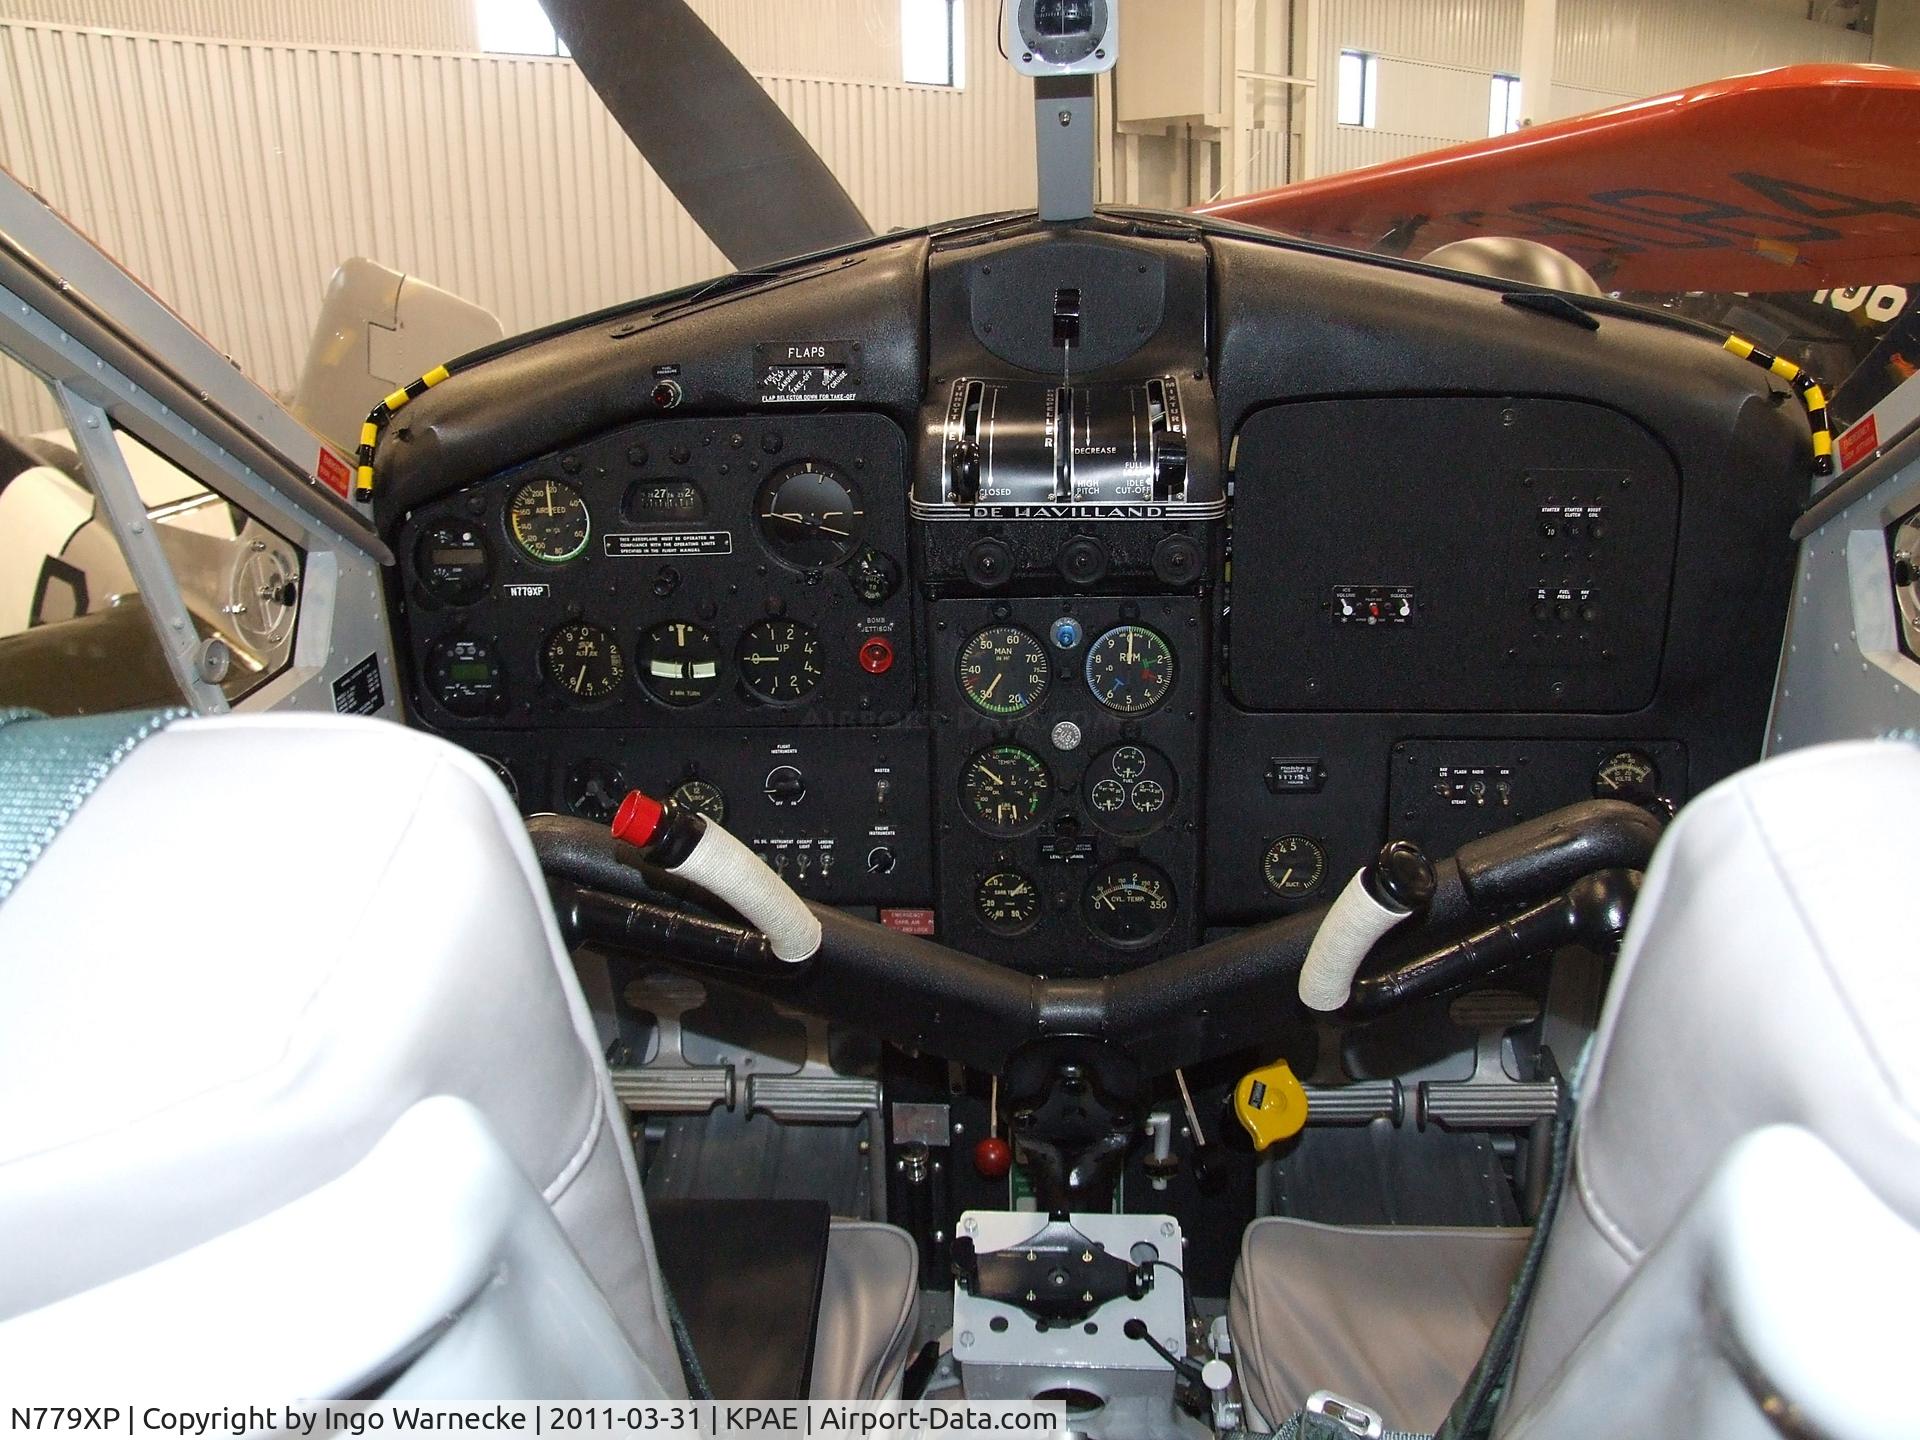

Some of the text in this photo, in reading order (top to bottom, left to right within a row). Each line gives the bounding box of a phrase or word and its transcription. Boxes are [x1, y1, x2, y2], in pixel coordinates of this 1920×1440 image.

[788, 346, 825, 358] FLAPS
[764, 370, 779, 386] FULL
[772, 371, 785, 385] FLAP
[777, 370, 798, 392] LANDING
[790, 370, 813, 394] TAKE-OFF
[830, 370, 848, 389] CRUISE
[1166, 382, 1182, 433] MIXTURE
[1074, 447, 1117, 455] DECREASE
[654, 489, 666, 498] 27
[980, 488, 1012, 496] CLOSED
[1077, 487, 1100, 495] PITCH
[1115, 487, 1151, 495] CUT-OFF
[974, 507, 1162, 518] DE HAVILLAND
[511, 587, 544, 597] N779XP
[566, 632, 573, 642] 9
[582, 628, 589, 637] 0
[787, 628, 794, 640] 2
[1007, 636, 1020, 645] 60
[1108, 639, 1115, 649] 9
[610, 645, 617, 654] 2
[776, 644, 790, 653] UP
[804, 643, 813, 654] 4
[980, 641, 993, 650] 50
[557, 646, 564, 655] 8
[1026, 654, 1038, 664] 70
[1095, 655, 1102, 664] 8
[1120, 653, 1141, 662] RM
[1157, 655, 1164, 664] 2
[558, 664, 565, 672] 7
[804, 661, 813, 672] 4
[968, 666, 981, 674] 40
[612, 667, 618, 676] 3
[570, 677, 577, 685] 6
[602, 678, 609, 686] 4
[790, 676, 798, 687] 2
[1029, 674, 1039, 684] 10
[1095, 674, 1102, 684] 7
[1156, 675, 1163, 684] 3
[586, 682, 593, 691] 5
[980, 690, 993, 699] 30
[1107, 690, 1114, 699] 6
[1144, 689, 1152, 698] 4
[1009, 694, 1021, 704] 20
[1126, 695, 1132, 704] 5
[1056, 727, 1078, 746] PUSH
[1280, 845, 1287, 853] 4
[1290, 842, 1297, 851] 5
[1272, 853, 1279, 863] 3
[1132, 873, 1138, 881] 2
[1154, 881, 1160, 889] 3
[1095, 902, 1101, 910] 0
[1150, 901, 1168, 909] 350
